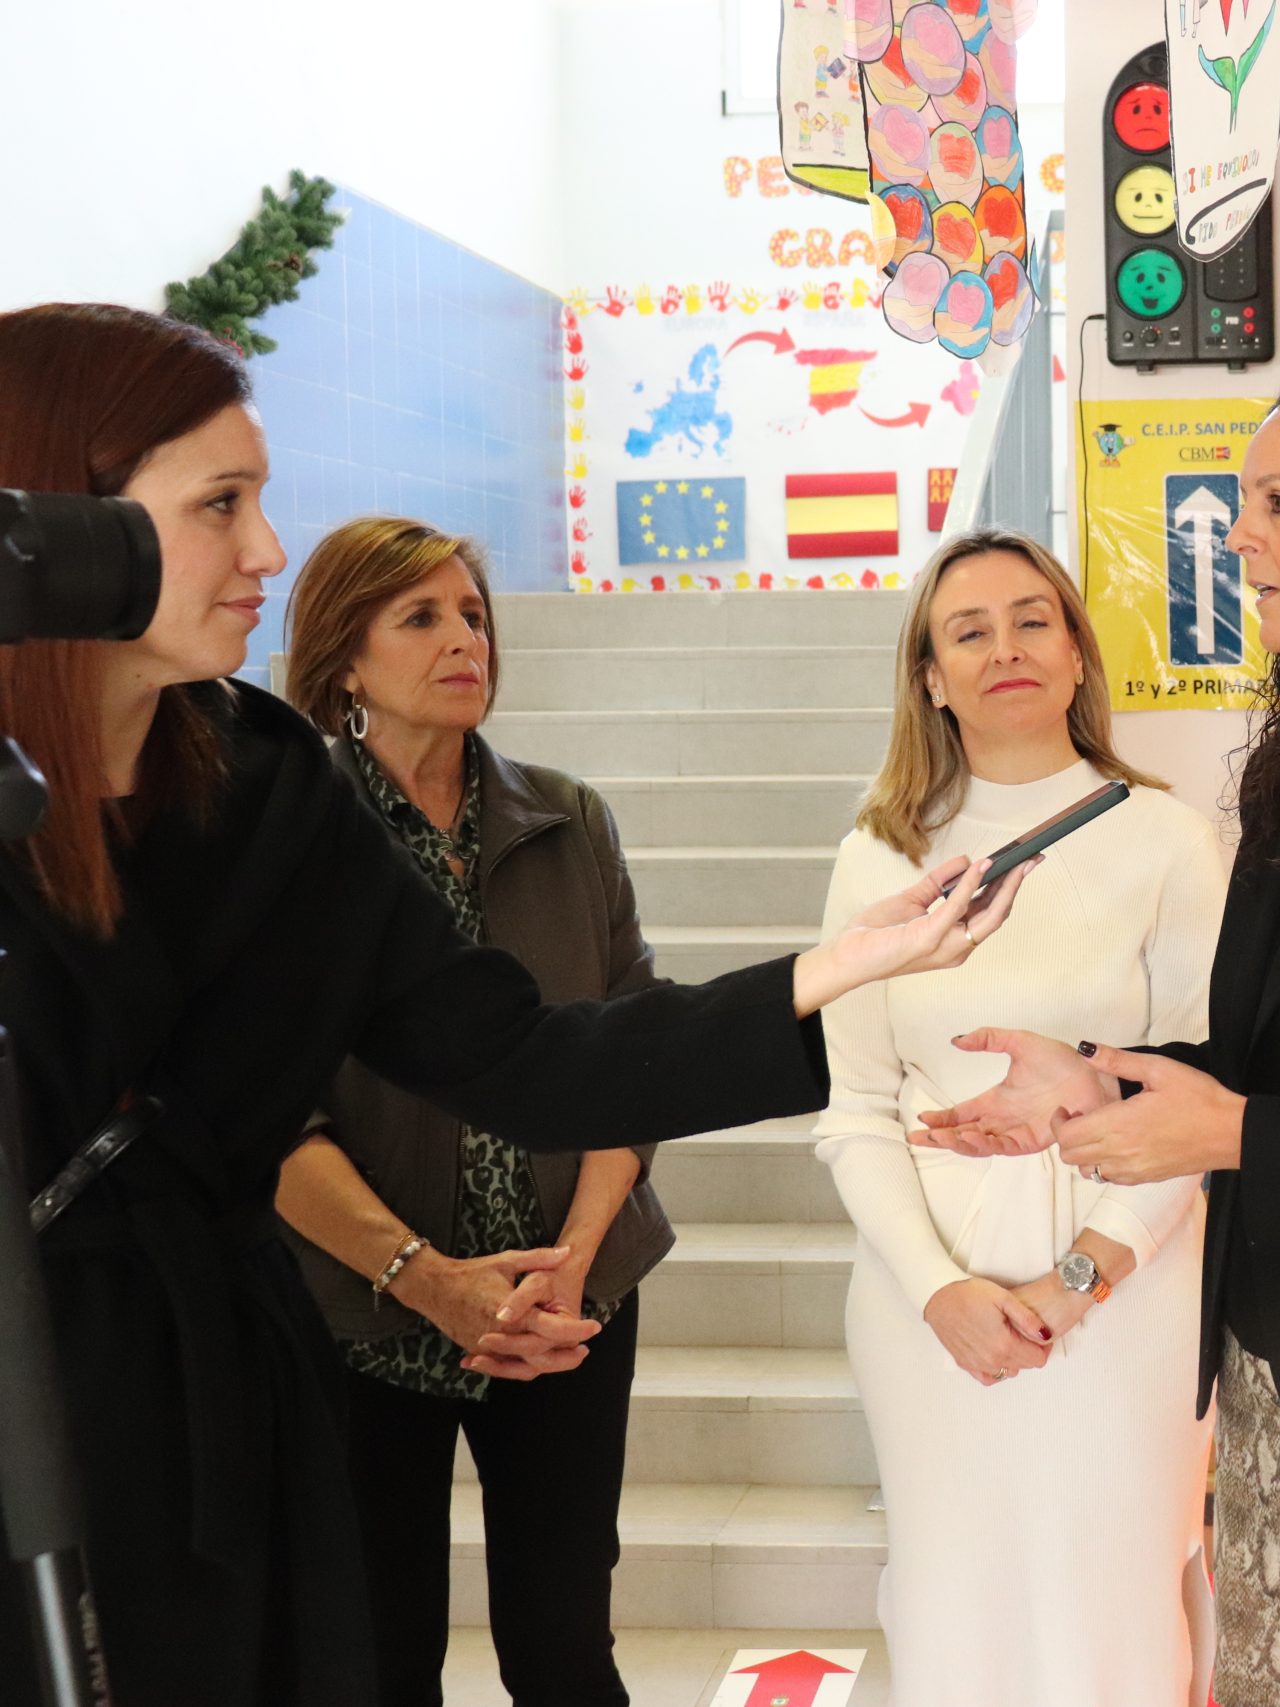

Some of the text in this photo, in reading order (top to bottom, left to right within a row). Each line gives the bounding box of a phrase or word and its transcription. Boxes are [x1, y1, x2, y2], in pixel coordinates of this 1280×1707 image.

[723, 156, 812, 198] PE
[1142, 423, 1190, 437] C.E.I.P.
[1196, 422, 1228, 435] SAN
[1125, 681, 1144, 696] 1º
[1151, 684, 1161, 699] y
[1167, 680, 1187, 695] 2º
